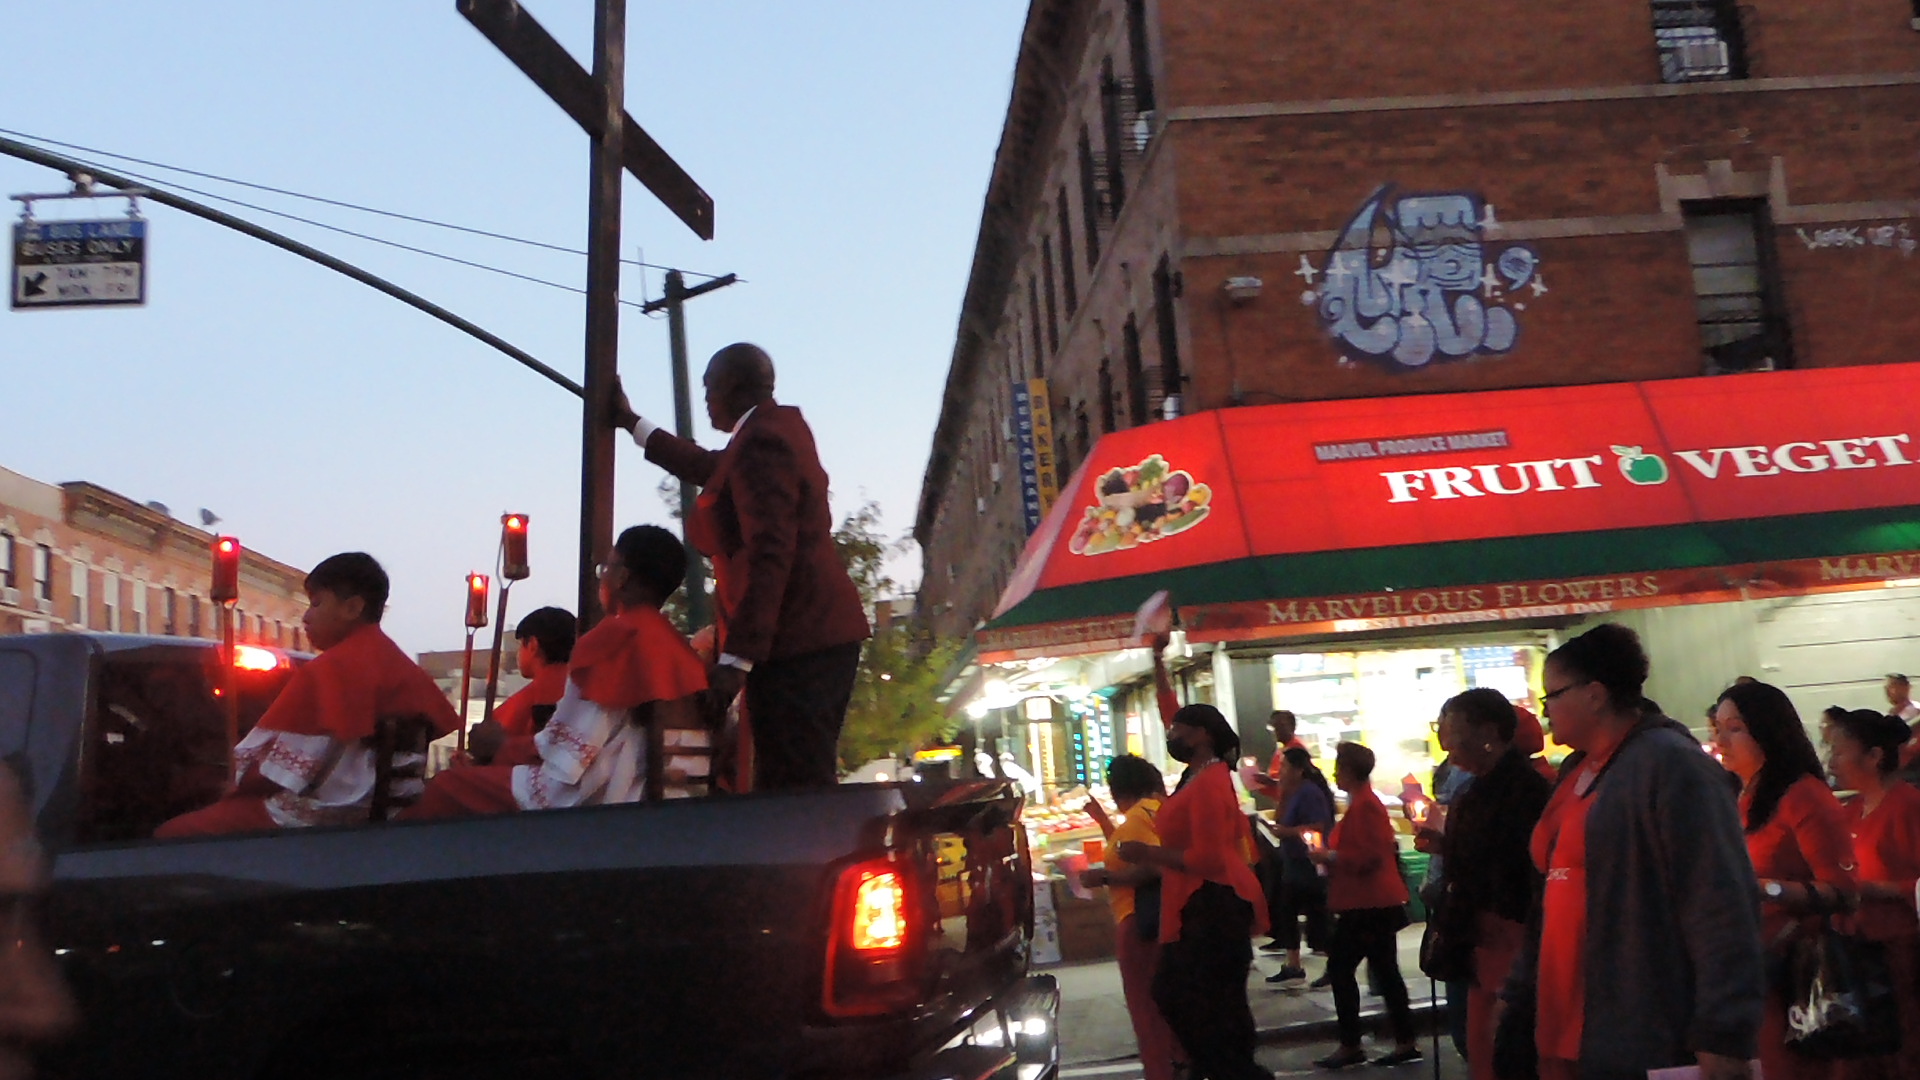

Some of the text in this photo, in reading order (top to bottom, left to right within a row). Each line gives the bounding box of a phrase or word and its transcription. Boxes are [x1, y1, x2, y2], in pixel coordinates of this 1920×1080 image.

[1315, 430, 1508, 460] MARVEL PRODUCE MARKET
[1379, 433, 1920, 503] FRUIT VEGET
[1265, 575, 1660, 624] MARVELOUS FLOWERS
[1405, 608, 1500, 626] FLOWERS
[1504, 603, 1570, 618] EVERY
[1573, 600, 1613, 613] DAY
